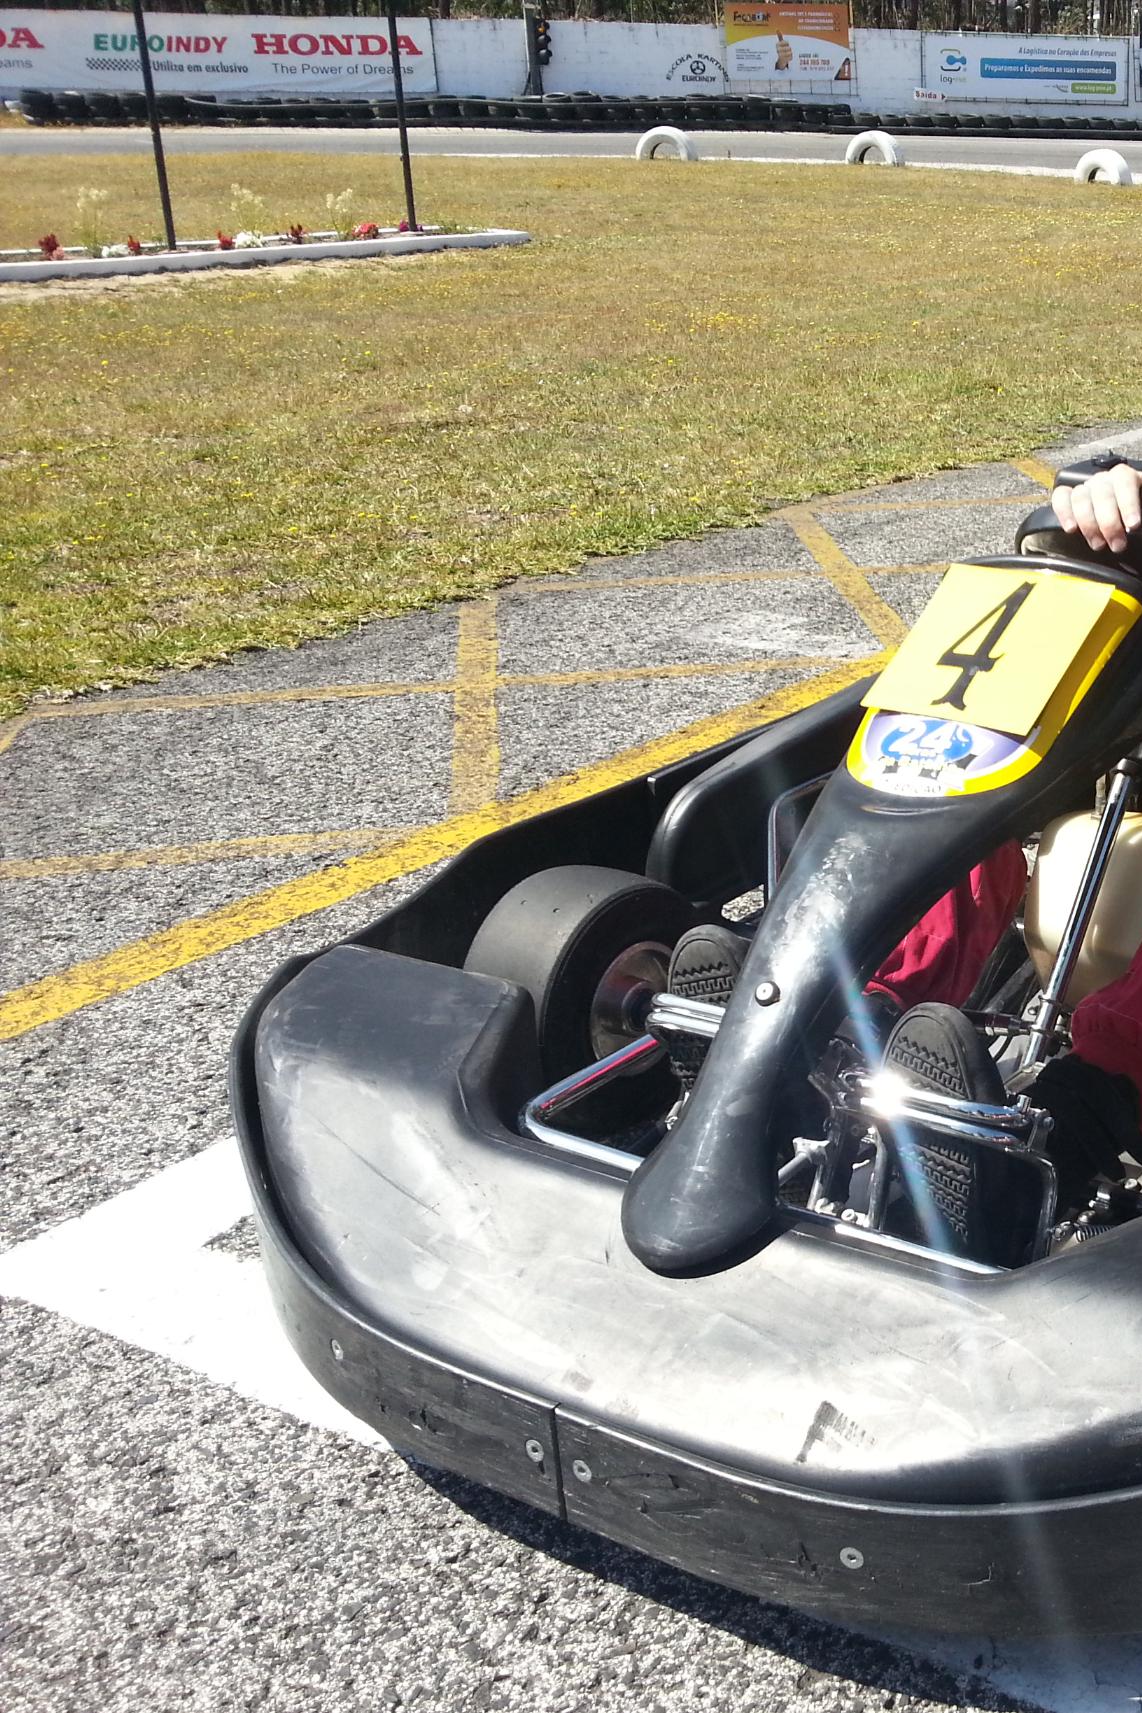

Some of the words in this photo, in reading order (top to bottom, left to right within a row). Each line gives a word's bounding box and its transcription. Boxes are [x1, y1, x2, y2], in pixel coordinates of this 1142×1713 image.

[0, 27, 45, 49] A
[251, 33, 423, 56] HONDA
[152, 61, 185, 72] Utiliza
[187, 64, 203, 73] em
[205, 62, 249, 73] exclusivo
[272, 63, 296, 75] The
[302, 63, 342, 75] Power
[347, 63, 359, 75] of
[931, 581, 1038, 711] 4
